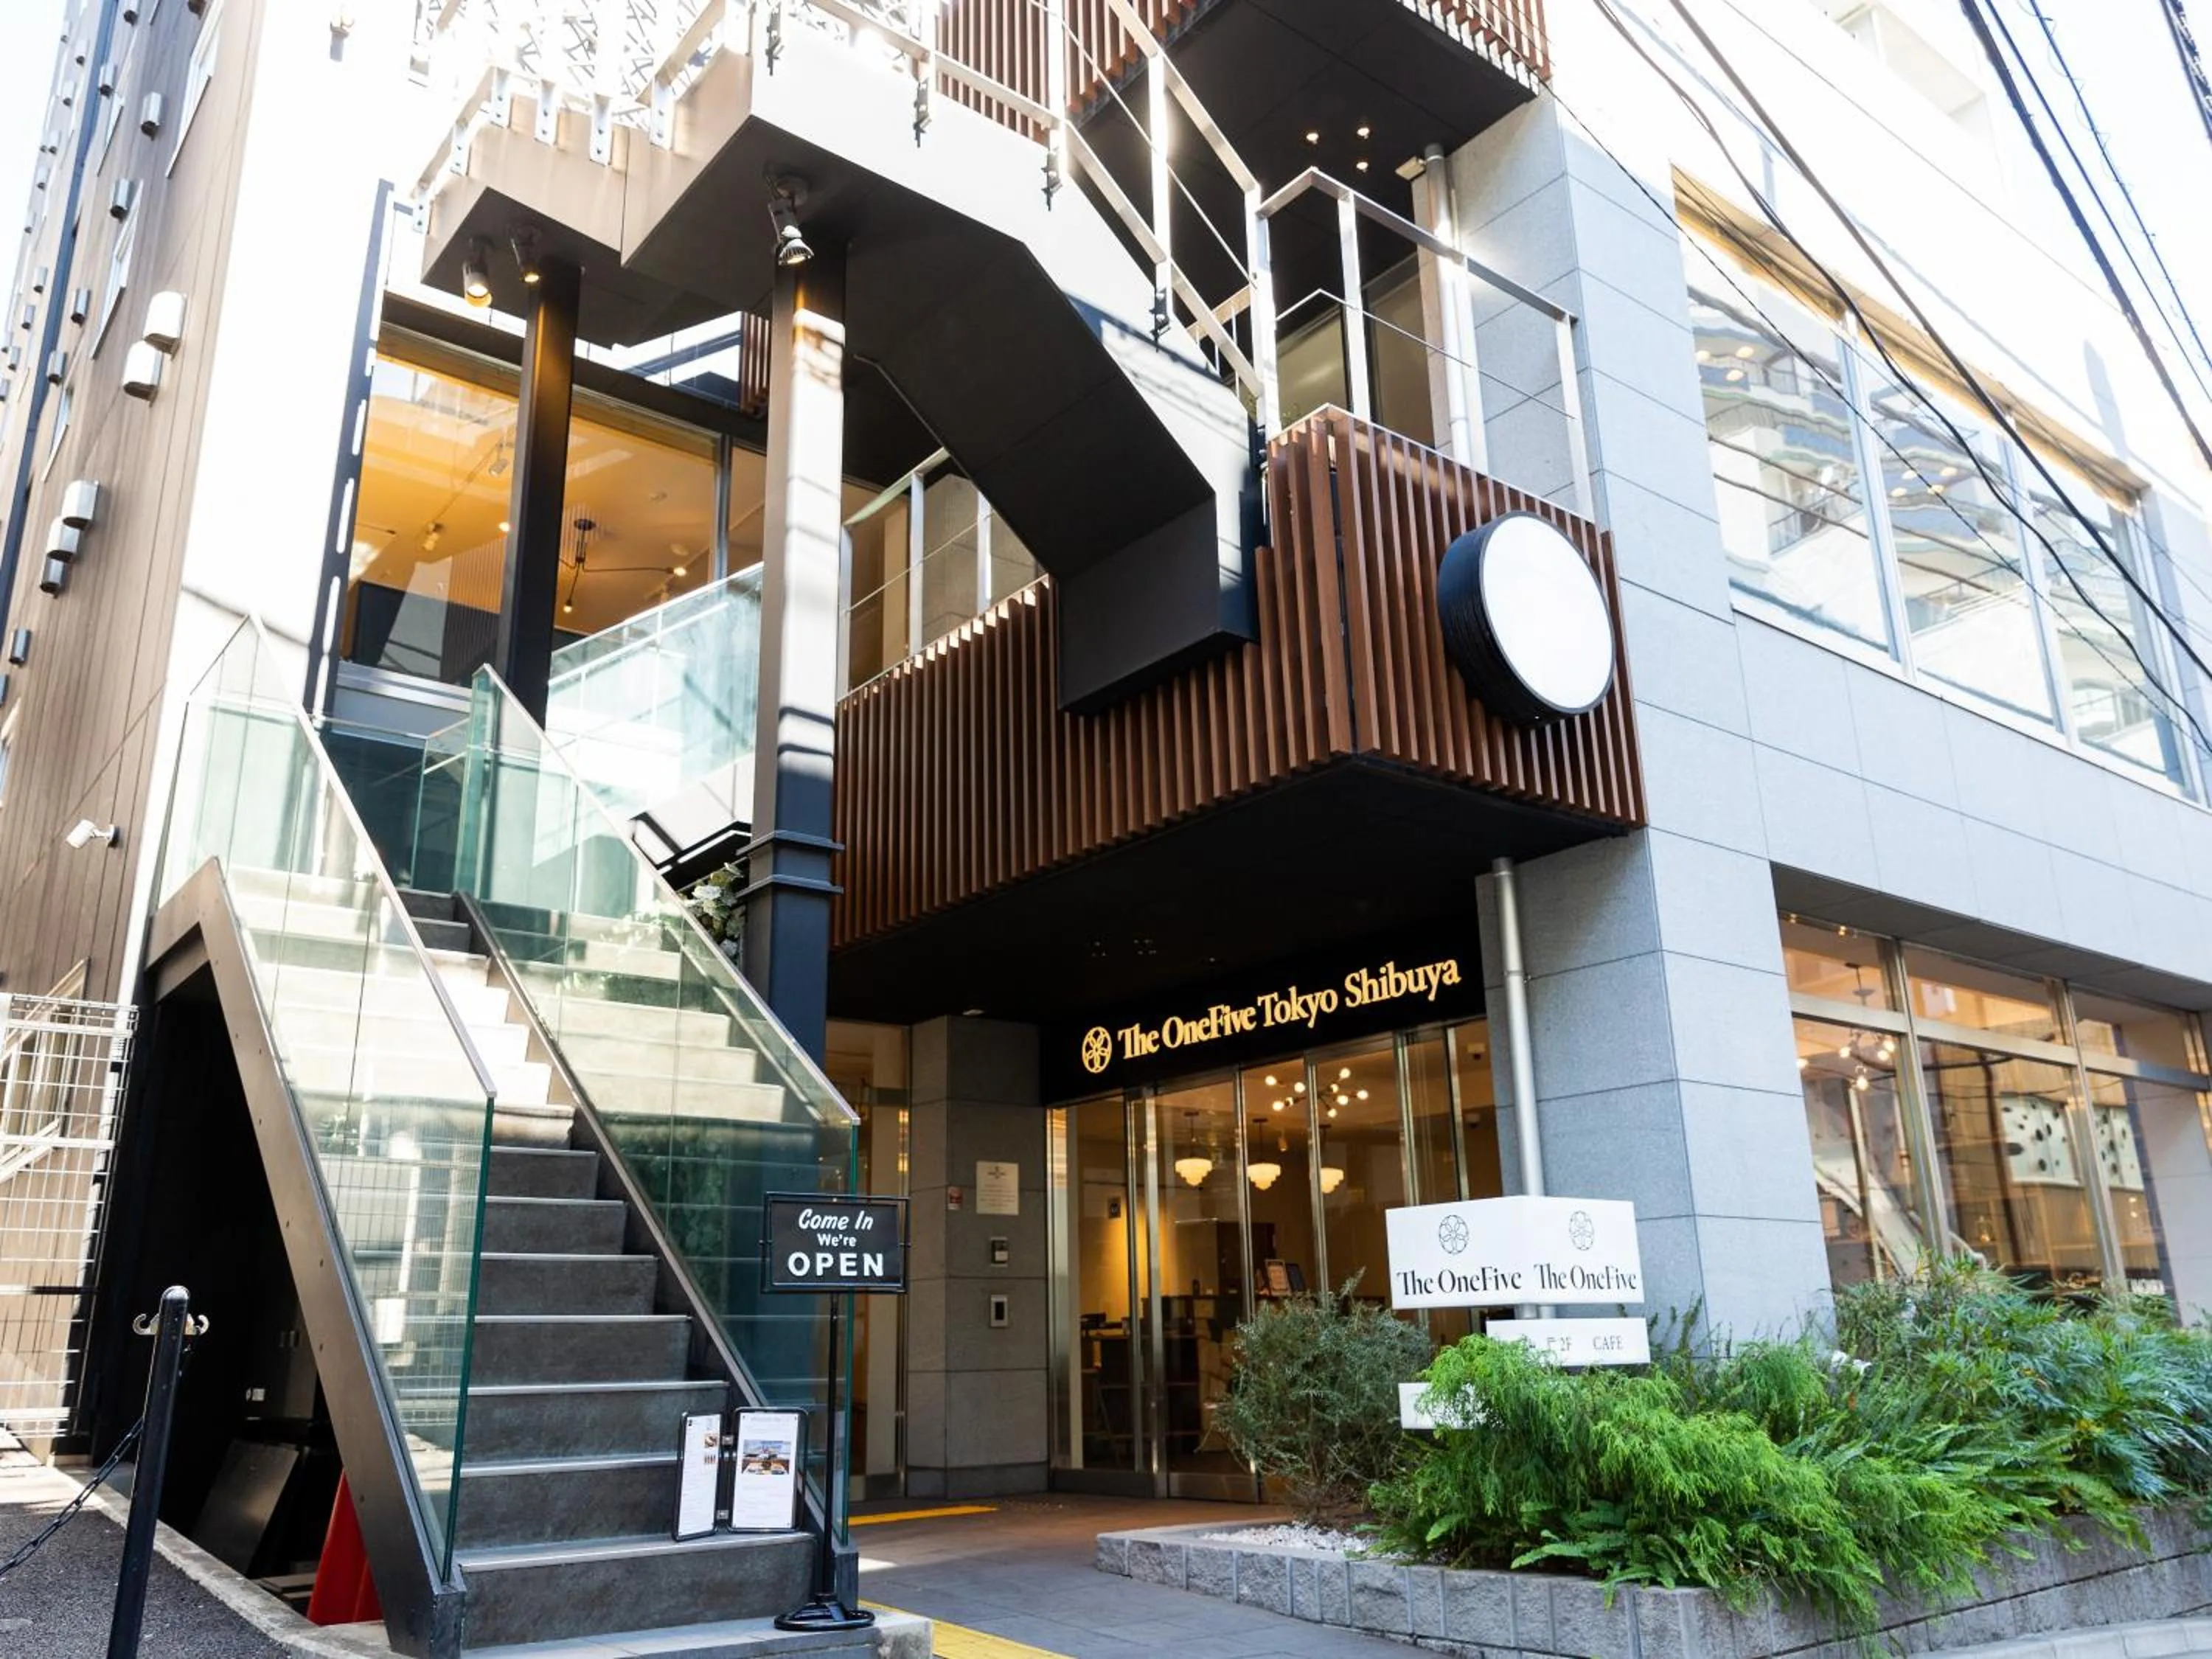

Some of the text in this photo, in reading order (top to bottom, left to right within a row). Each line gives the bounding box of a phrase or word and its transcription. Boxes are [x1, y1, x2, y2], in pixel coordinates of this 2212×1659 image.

[1117, 959, 1461, 1060] The OneFive Tokyo Shibuya
[799, 1208, 874, 1231] Come In
[816, 1233, 858, 1247] We're
[787, 1251, 884, 1277] OPEN
[1532, 1262, 1638, 1291] The OneFive
[1396, 1265, 1523, 1296] The OneFive
